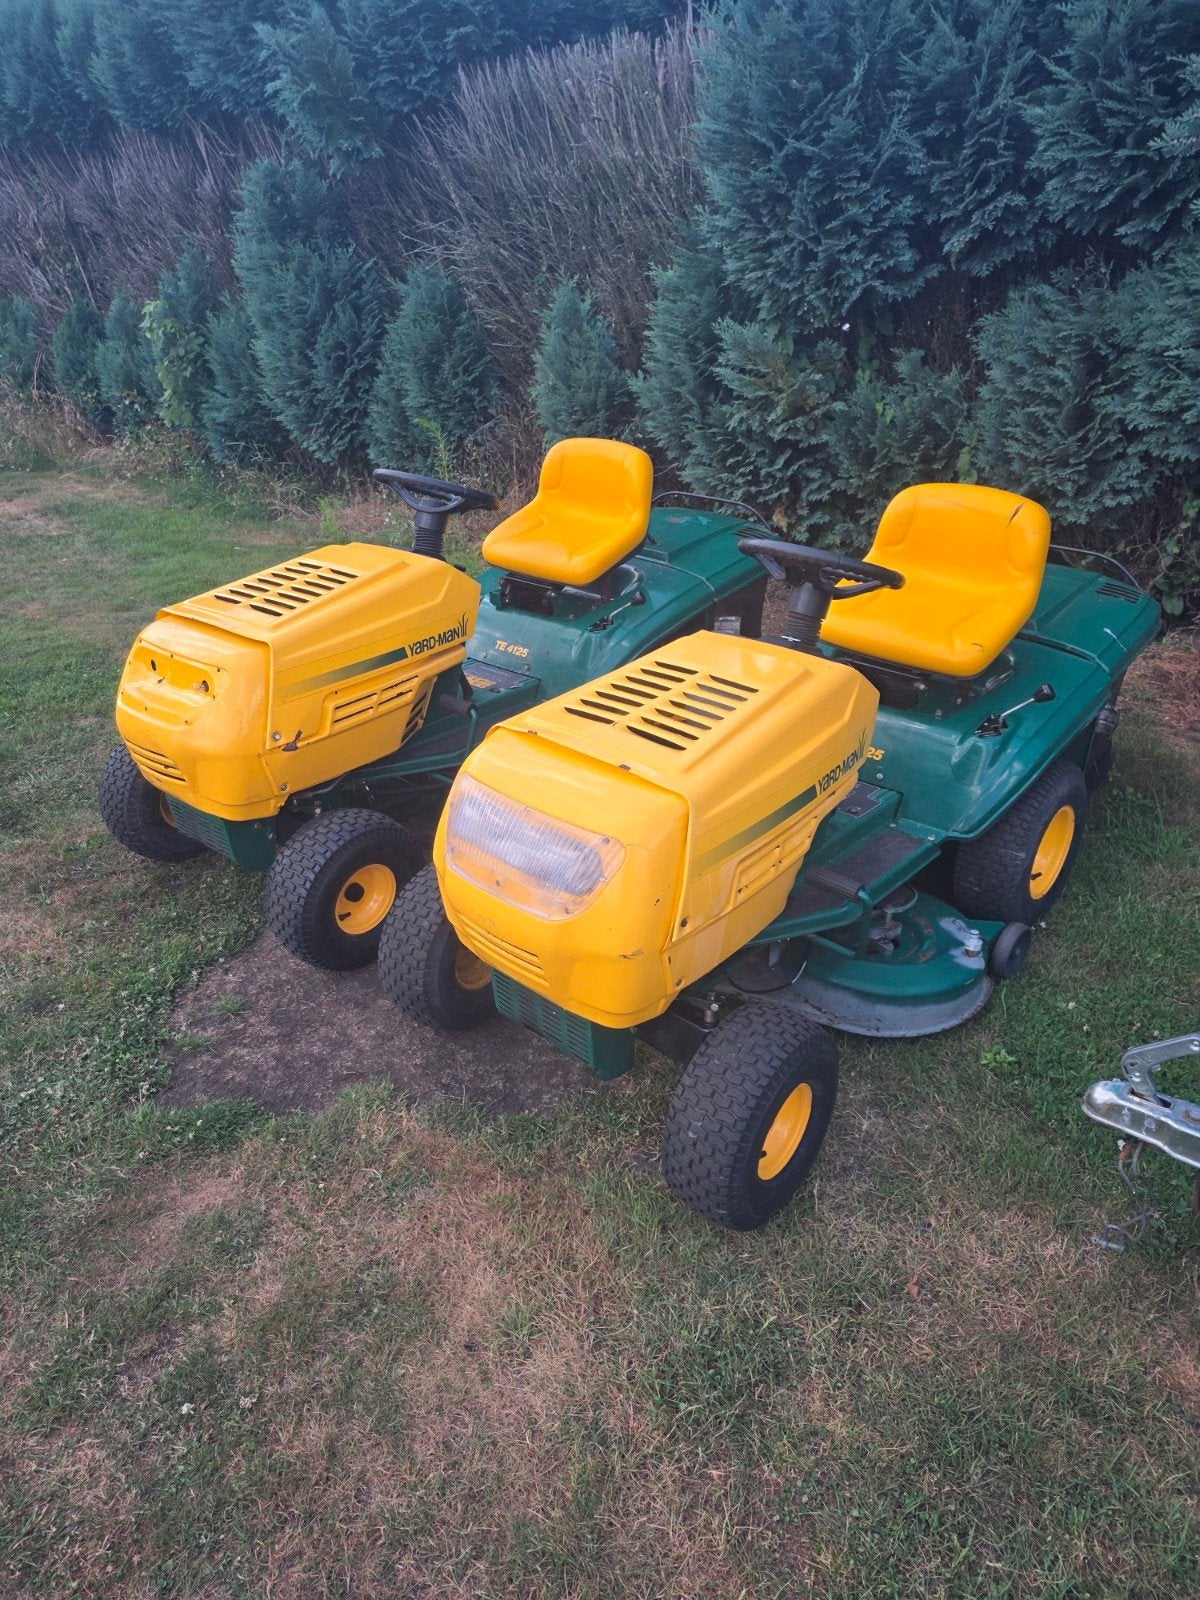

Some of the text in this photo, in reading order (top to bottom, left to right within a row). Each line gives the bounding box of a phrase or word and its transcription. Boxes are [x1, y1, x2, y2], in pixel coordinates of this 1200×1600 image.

[495, 640, 529, 657] TE 4125
[867, 746, 885, 760] 25
